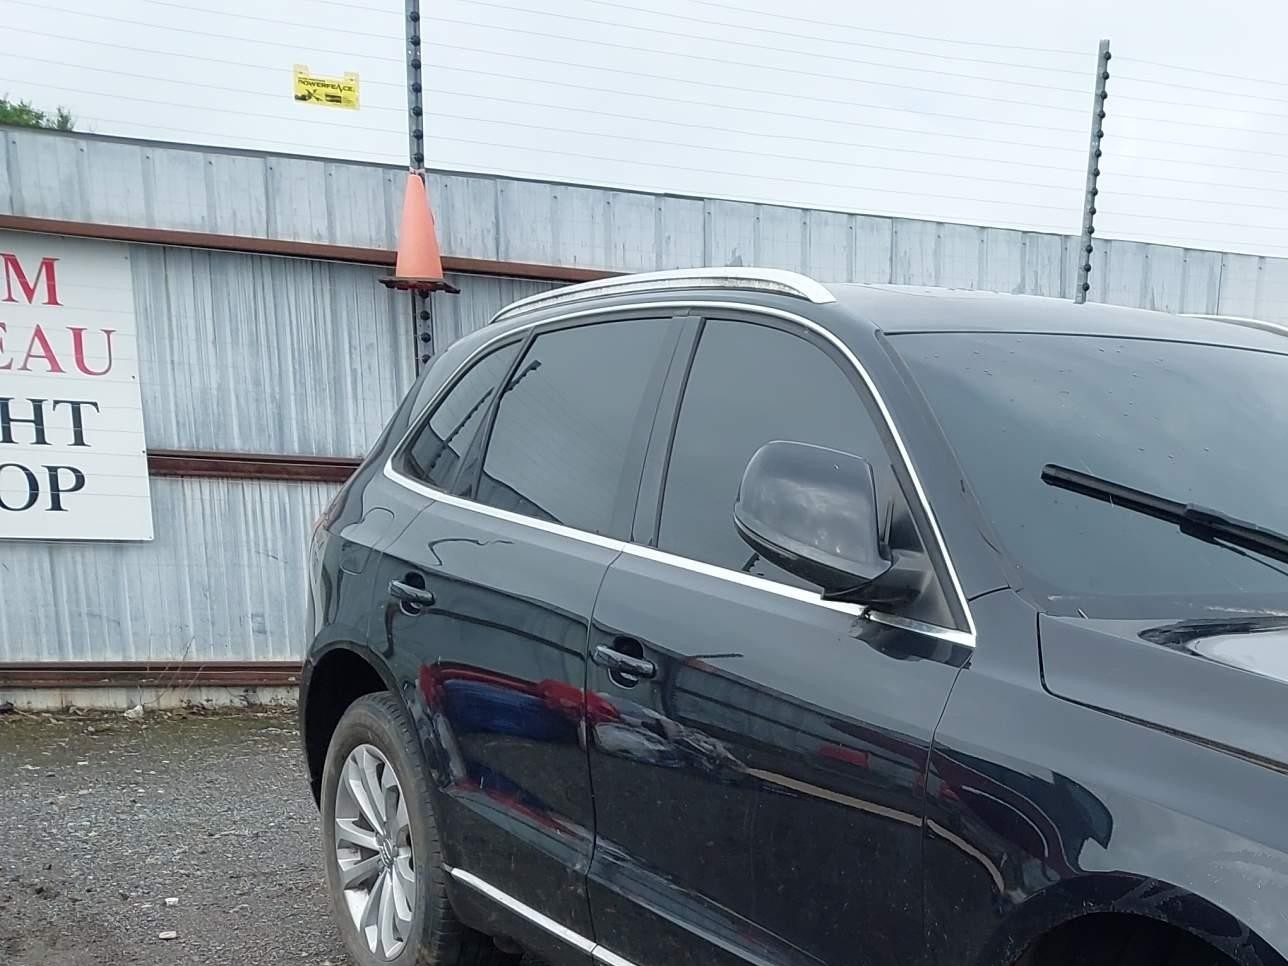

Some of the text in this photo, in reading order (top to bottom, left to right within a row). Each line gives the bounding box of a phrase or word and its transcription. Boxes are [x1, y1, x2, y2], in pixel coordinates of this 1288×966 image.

[0, 253, 64, 306] M
[0, 396, 100, 447] HT
[0, 463, 86, 512] OP
